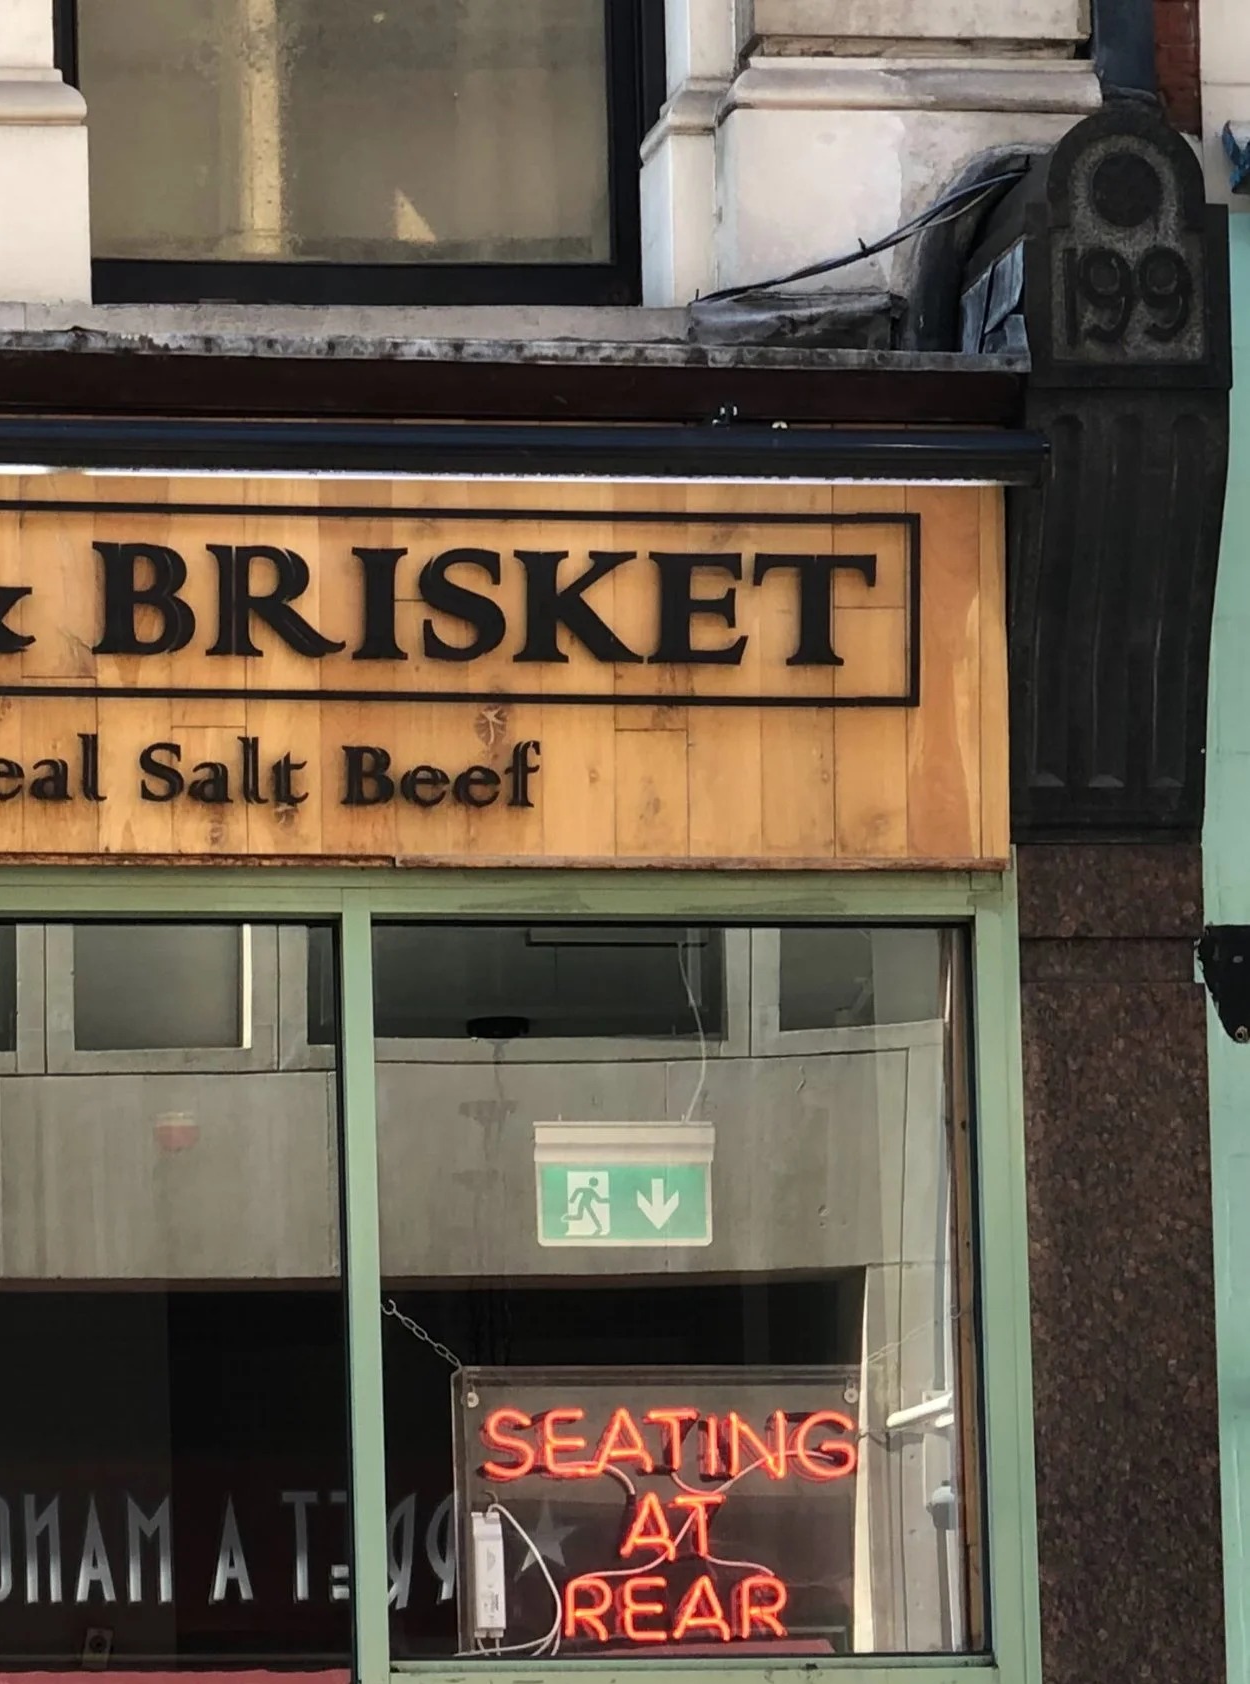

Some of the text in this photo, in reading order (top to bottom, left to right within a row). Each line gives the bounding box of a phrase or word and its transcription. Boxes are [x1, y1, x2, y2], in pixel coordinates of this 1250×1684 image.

[91, 541, 877, 667] BRISKET
[137, 736, 310, 805] Salt
[340, 739, 541, 809] Beef
[480, 1406, 859, 1483] SEATING
[620, 1490, 726, 1561] AT
[562, 1575, 788, 1642] REAR
